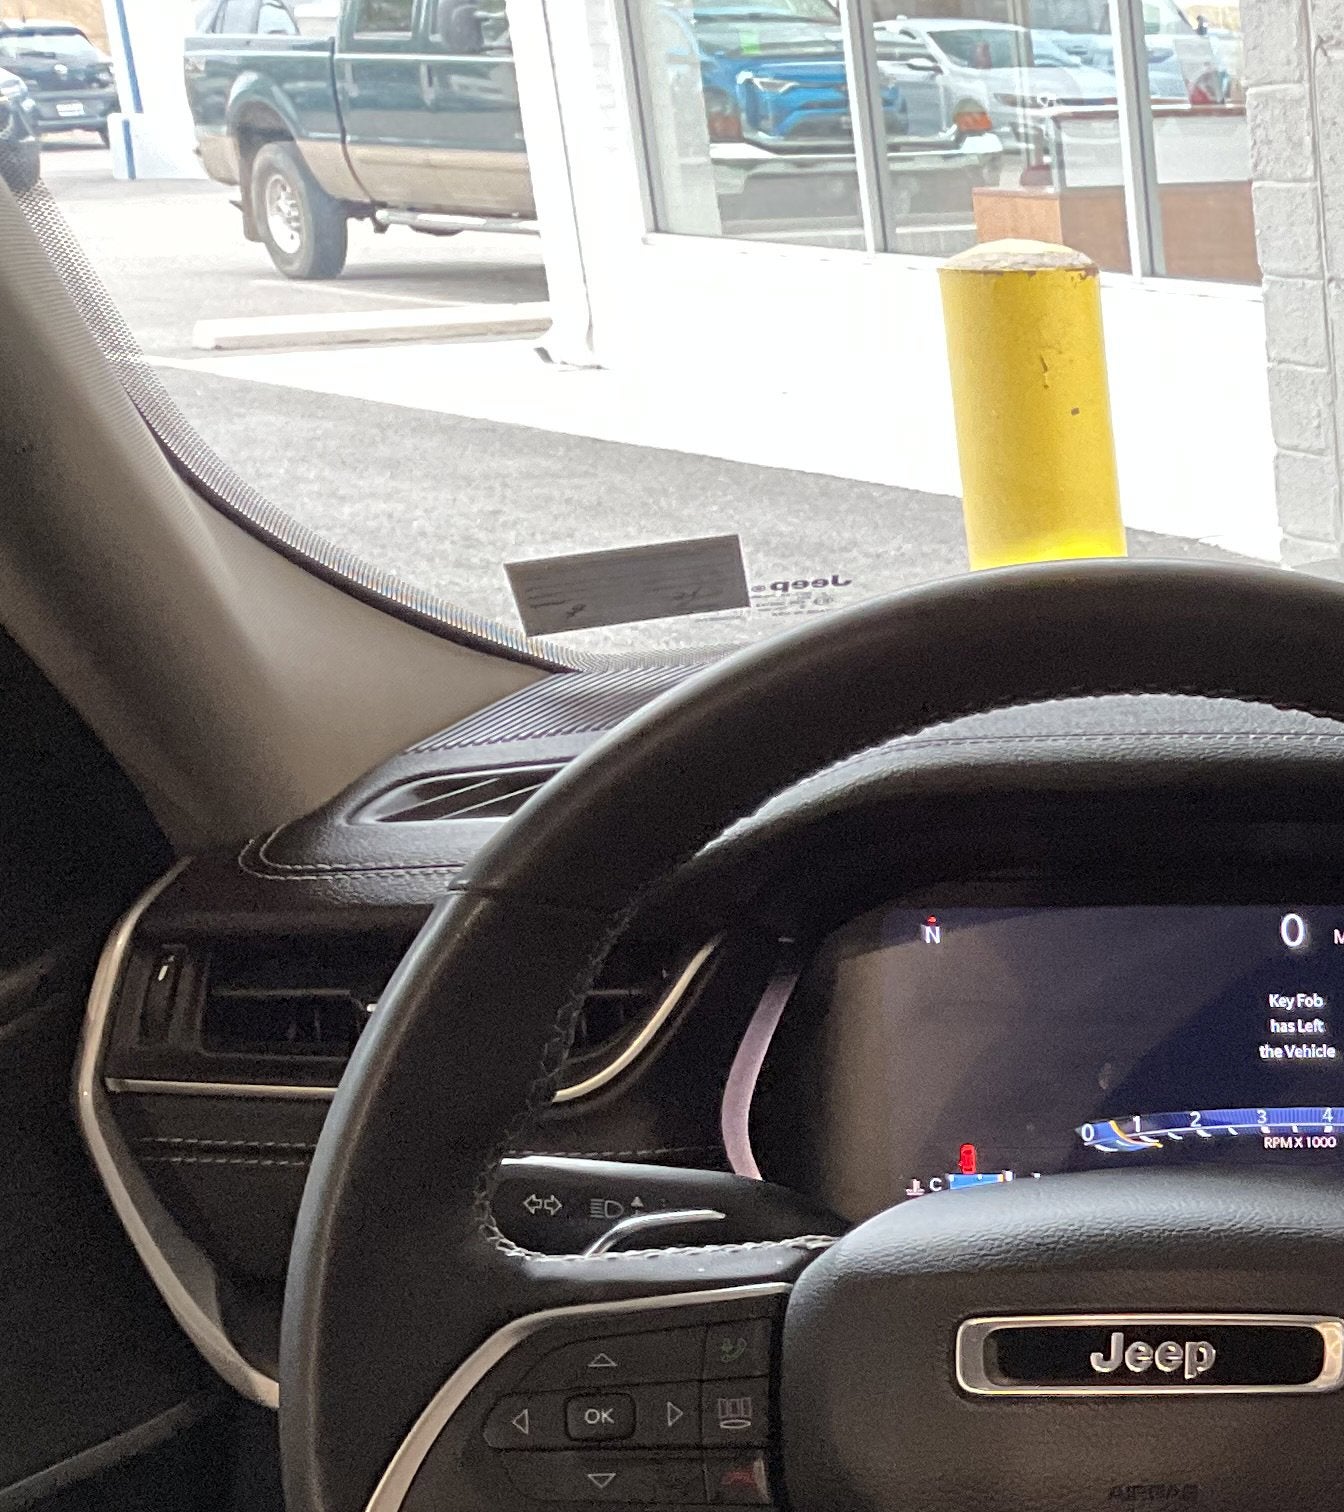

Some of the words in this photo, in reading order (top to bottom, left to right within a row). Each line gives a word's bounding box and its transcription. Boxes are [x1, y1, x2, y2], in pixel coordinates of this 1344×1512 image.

[1280, 913, 1307, 947] 0
[1268, 993, 1295, 1010] Key
[1297, 992, 1324, 1008] Fob
[1270, 1019, 1295, 1033] has
[1297, 1018, 1325, 1033] Left
[1259, 1045, 1283, 1059] the
[1284, 1044, 1336, 1059] Vehicle
[1189, 1111, 1202, 1128] 2
[1257, 1109, 1268, 1124] 3
[1321, 1107, 1334, 1123] 4
[1132, 1116, 1141, 1132] 1
[1081, 1123, 1094, 1142] 0
[1263, 1137, 1293, 1149] RPM
[1294, 1137, 1304, 1148] X
[1306, 1135, 1337, 1148] 1000
[1090, 1332, 1215, 1378] Jeep
[585, 1408, 615, 1425] OK
